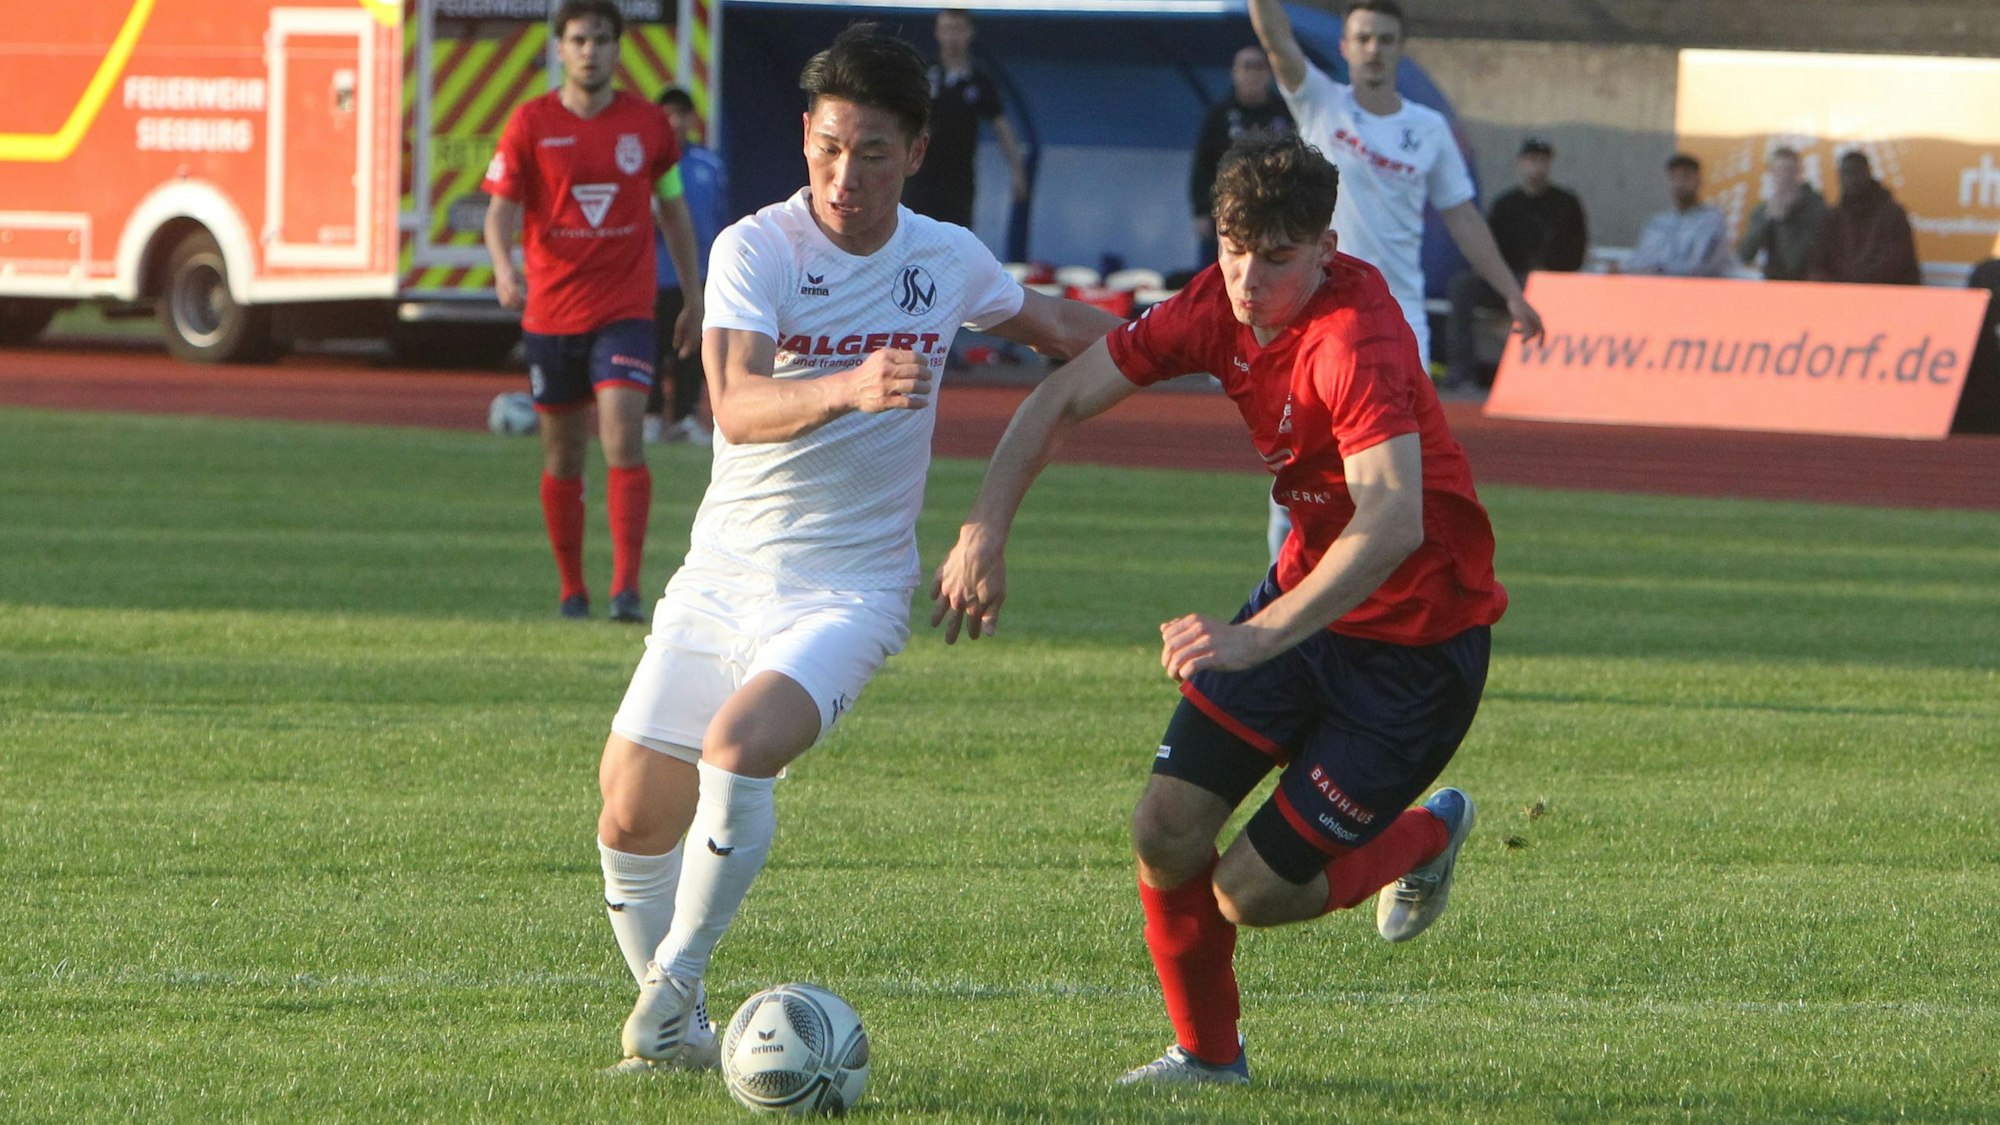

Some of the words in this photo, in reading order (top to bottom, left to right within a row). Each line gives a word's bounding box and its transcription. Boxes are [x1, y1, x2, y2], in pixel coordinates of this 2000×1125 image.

[123, 75, 267, 112] FEUERWEHR
[136, 116, 254, 153] SIEGBURG
[801, 286, 829, 296] erima
[792, 357, 817, 367] und
[819, 357, 863, 369] transpo
[1517, 331, 1957, 385] www.mundorf.de
[1310, 767, 1375, 825] BAUHAUS
[751, 1044, 784, 1055] erima
